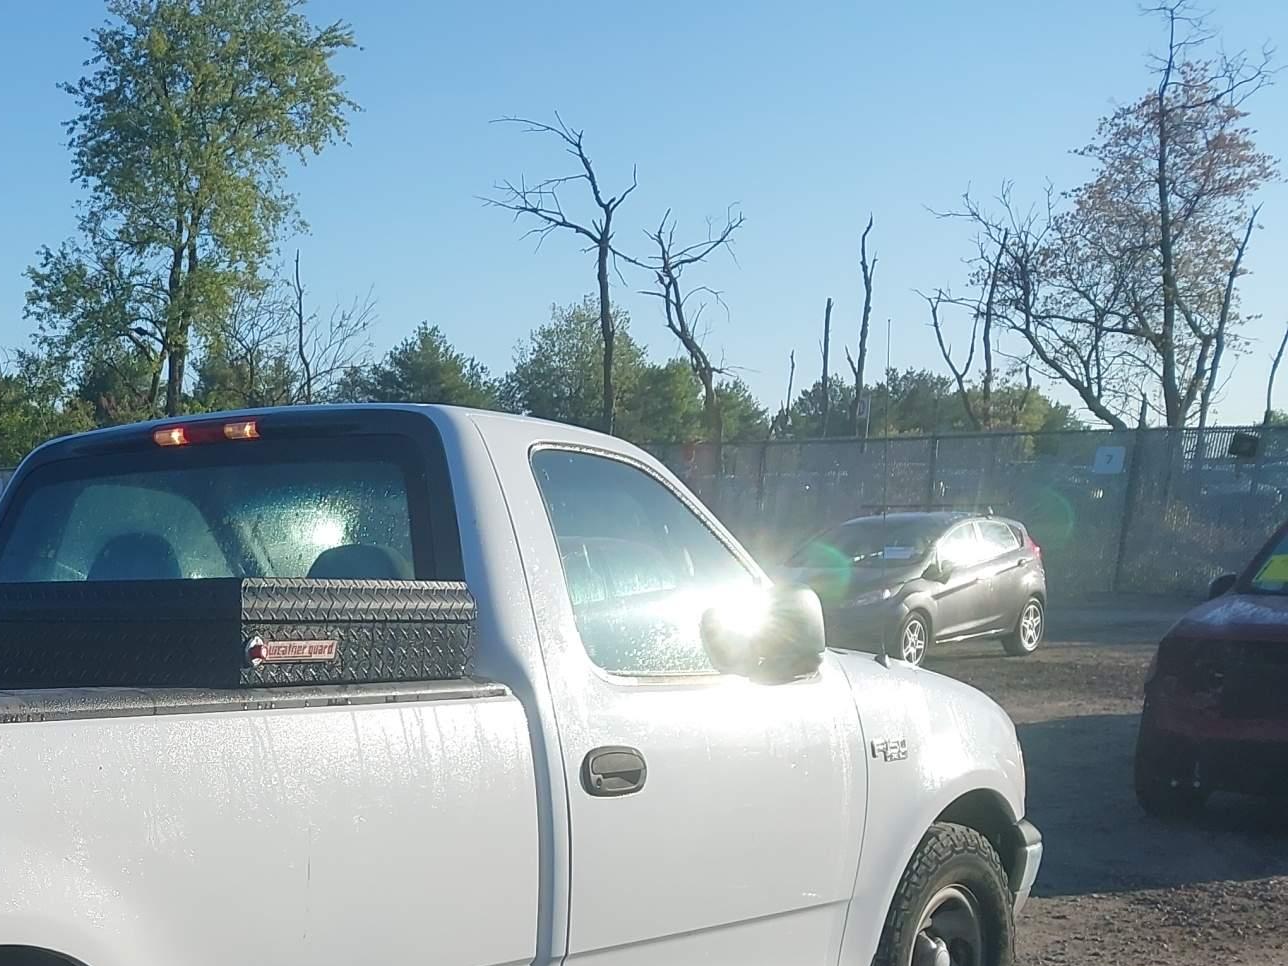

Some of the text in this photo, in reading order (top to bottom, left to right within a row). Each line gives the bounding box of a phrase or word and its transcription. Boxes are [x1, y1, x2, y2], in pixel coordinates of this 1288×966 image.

[1104, 454, 1114, 465] 7
[269, 642, 334, 658] weather guard
